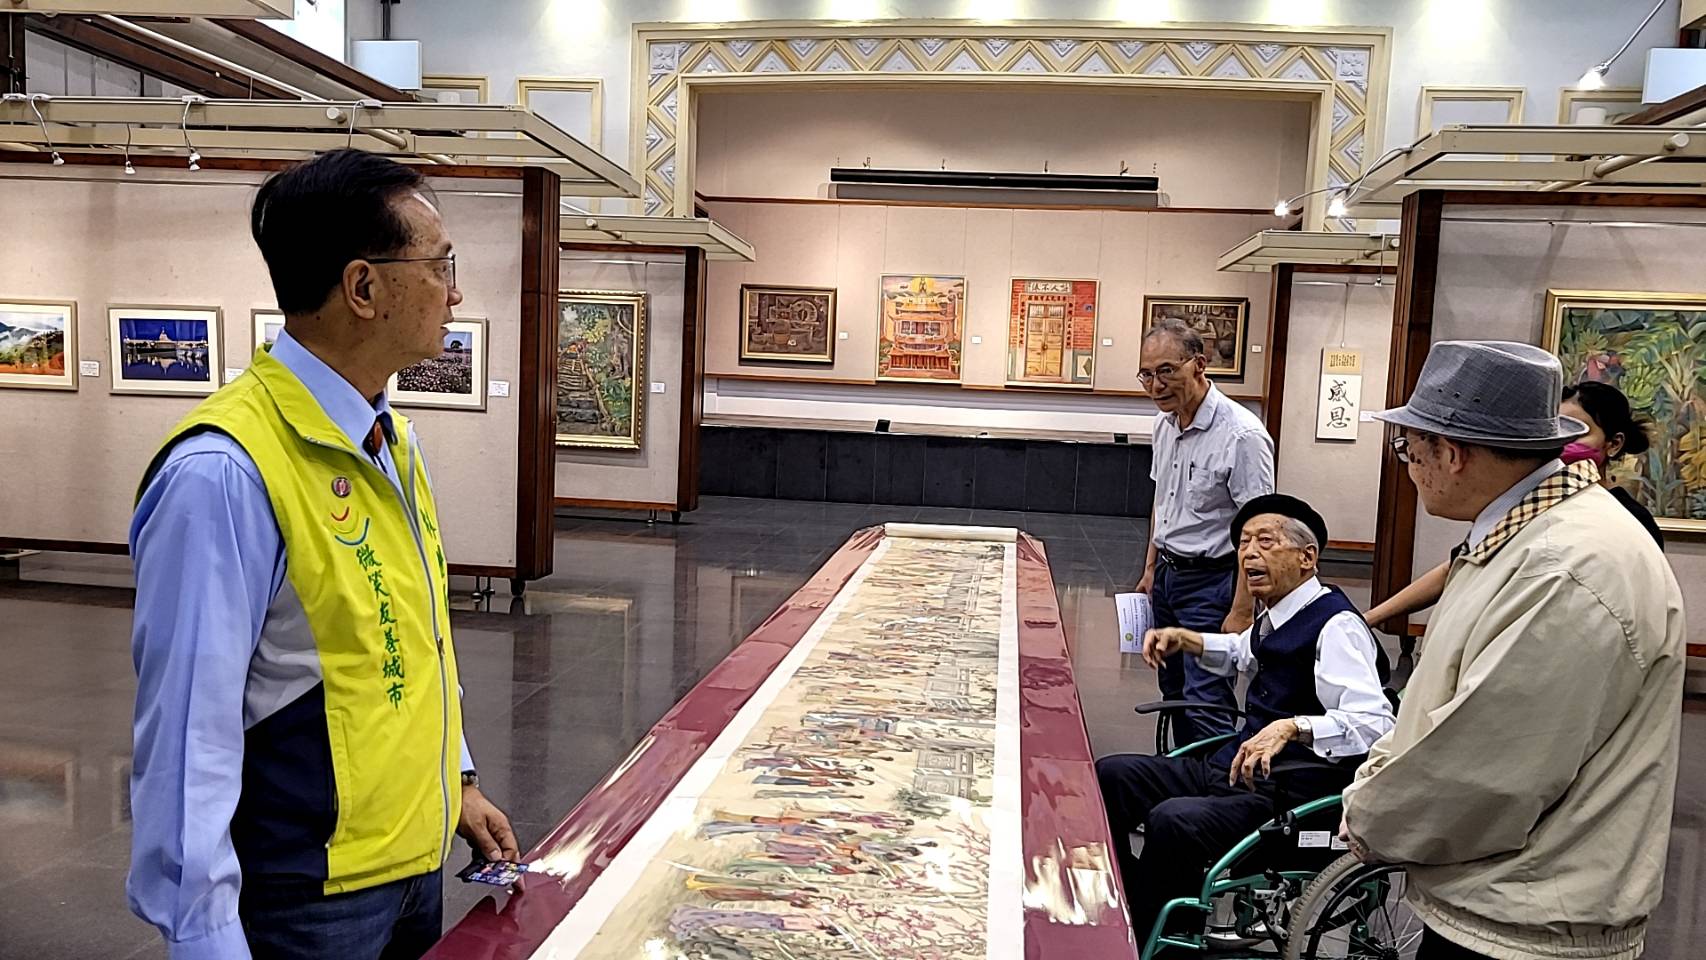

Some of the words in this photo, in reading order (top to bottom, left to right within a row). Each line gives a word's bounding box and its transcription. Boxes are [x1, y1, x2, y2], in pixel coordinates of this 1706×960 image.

[1326, 379, 1354, 429] 感恩
[355, 543, 405, 710] 微笑友善城市
